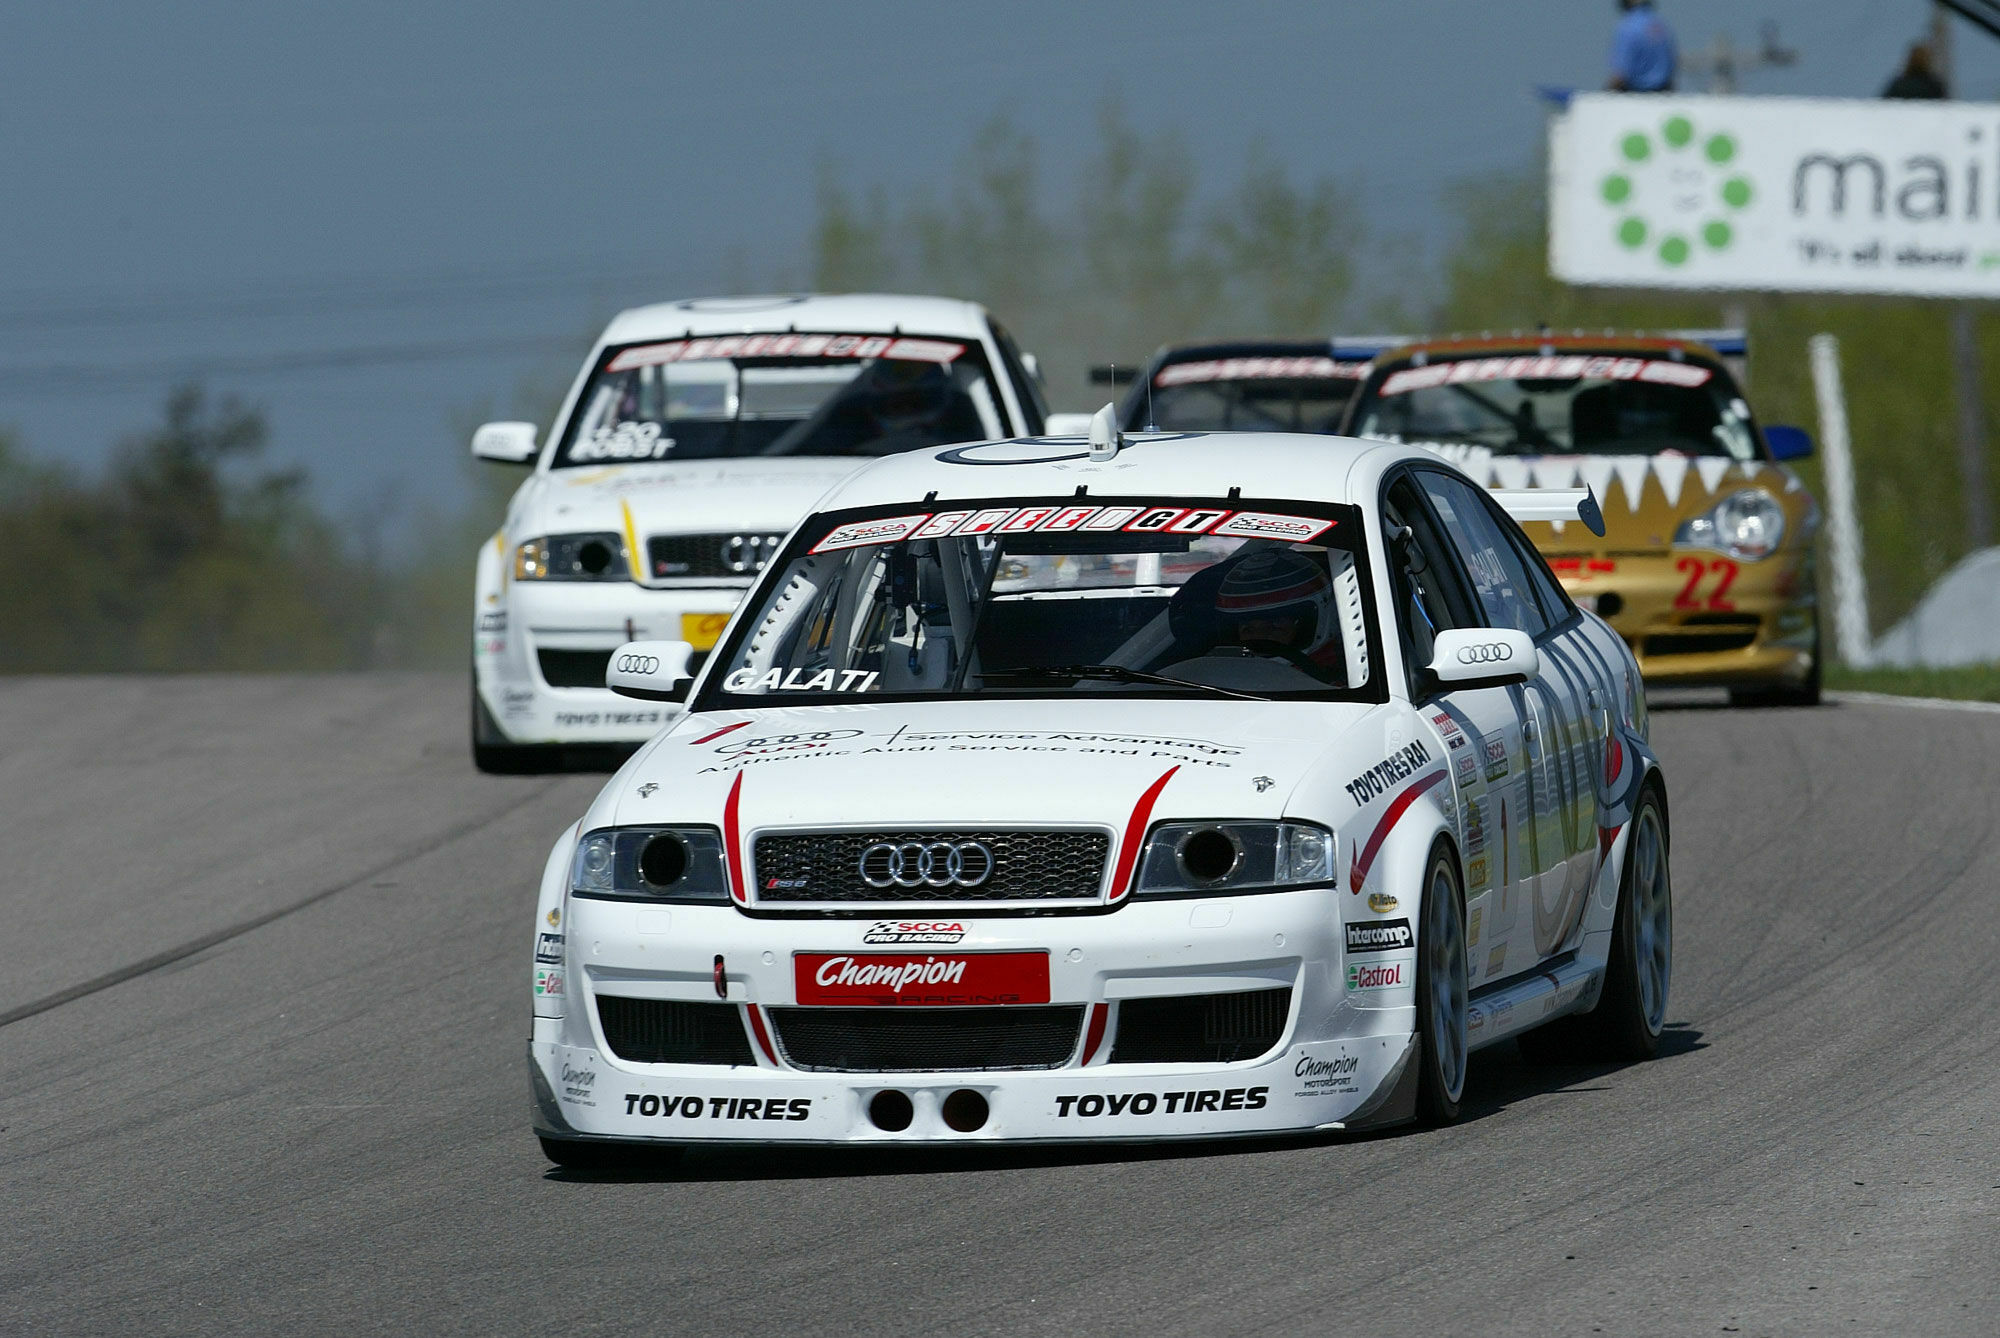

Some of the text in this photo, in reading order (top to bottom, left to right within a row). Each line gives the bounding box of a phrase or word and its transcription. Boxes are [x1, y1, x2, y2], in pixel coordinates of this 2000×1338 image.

[1793, 125, 2000, 221] mai
[914, 507, 1216, 537] SPEED GT
[1258, 518, 1312, 532] SCCA
[1674, 556, 1739, 613] 22
[721, 667, 879, 692] GALATI
[904, 733, 1242, 755] Service Advantage
[697, 744, 1231, 774] Authentic Audi Service and Parts
[1345, 770, 1383, 807] TOYO
[1373, 751, 1413, 789] TIRES
[865, 932, 962, 943] PRO RACING
[897, 921, 964, 933] SCCA
[1347, 925, 1410, 946] Intercomp
[816, 956, 967, 993] Champion
[1358, 963, 1402, 988] Castrol
[1294, 1055, 1359, 1081] Champion
[624, 1093, 705, 1119] TOYO
[707, 1098, 812, 1122] TIRES
[1055, 1086, 1269, 1118] TOYO TIRES
